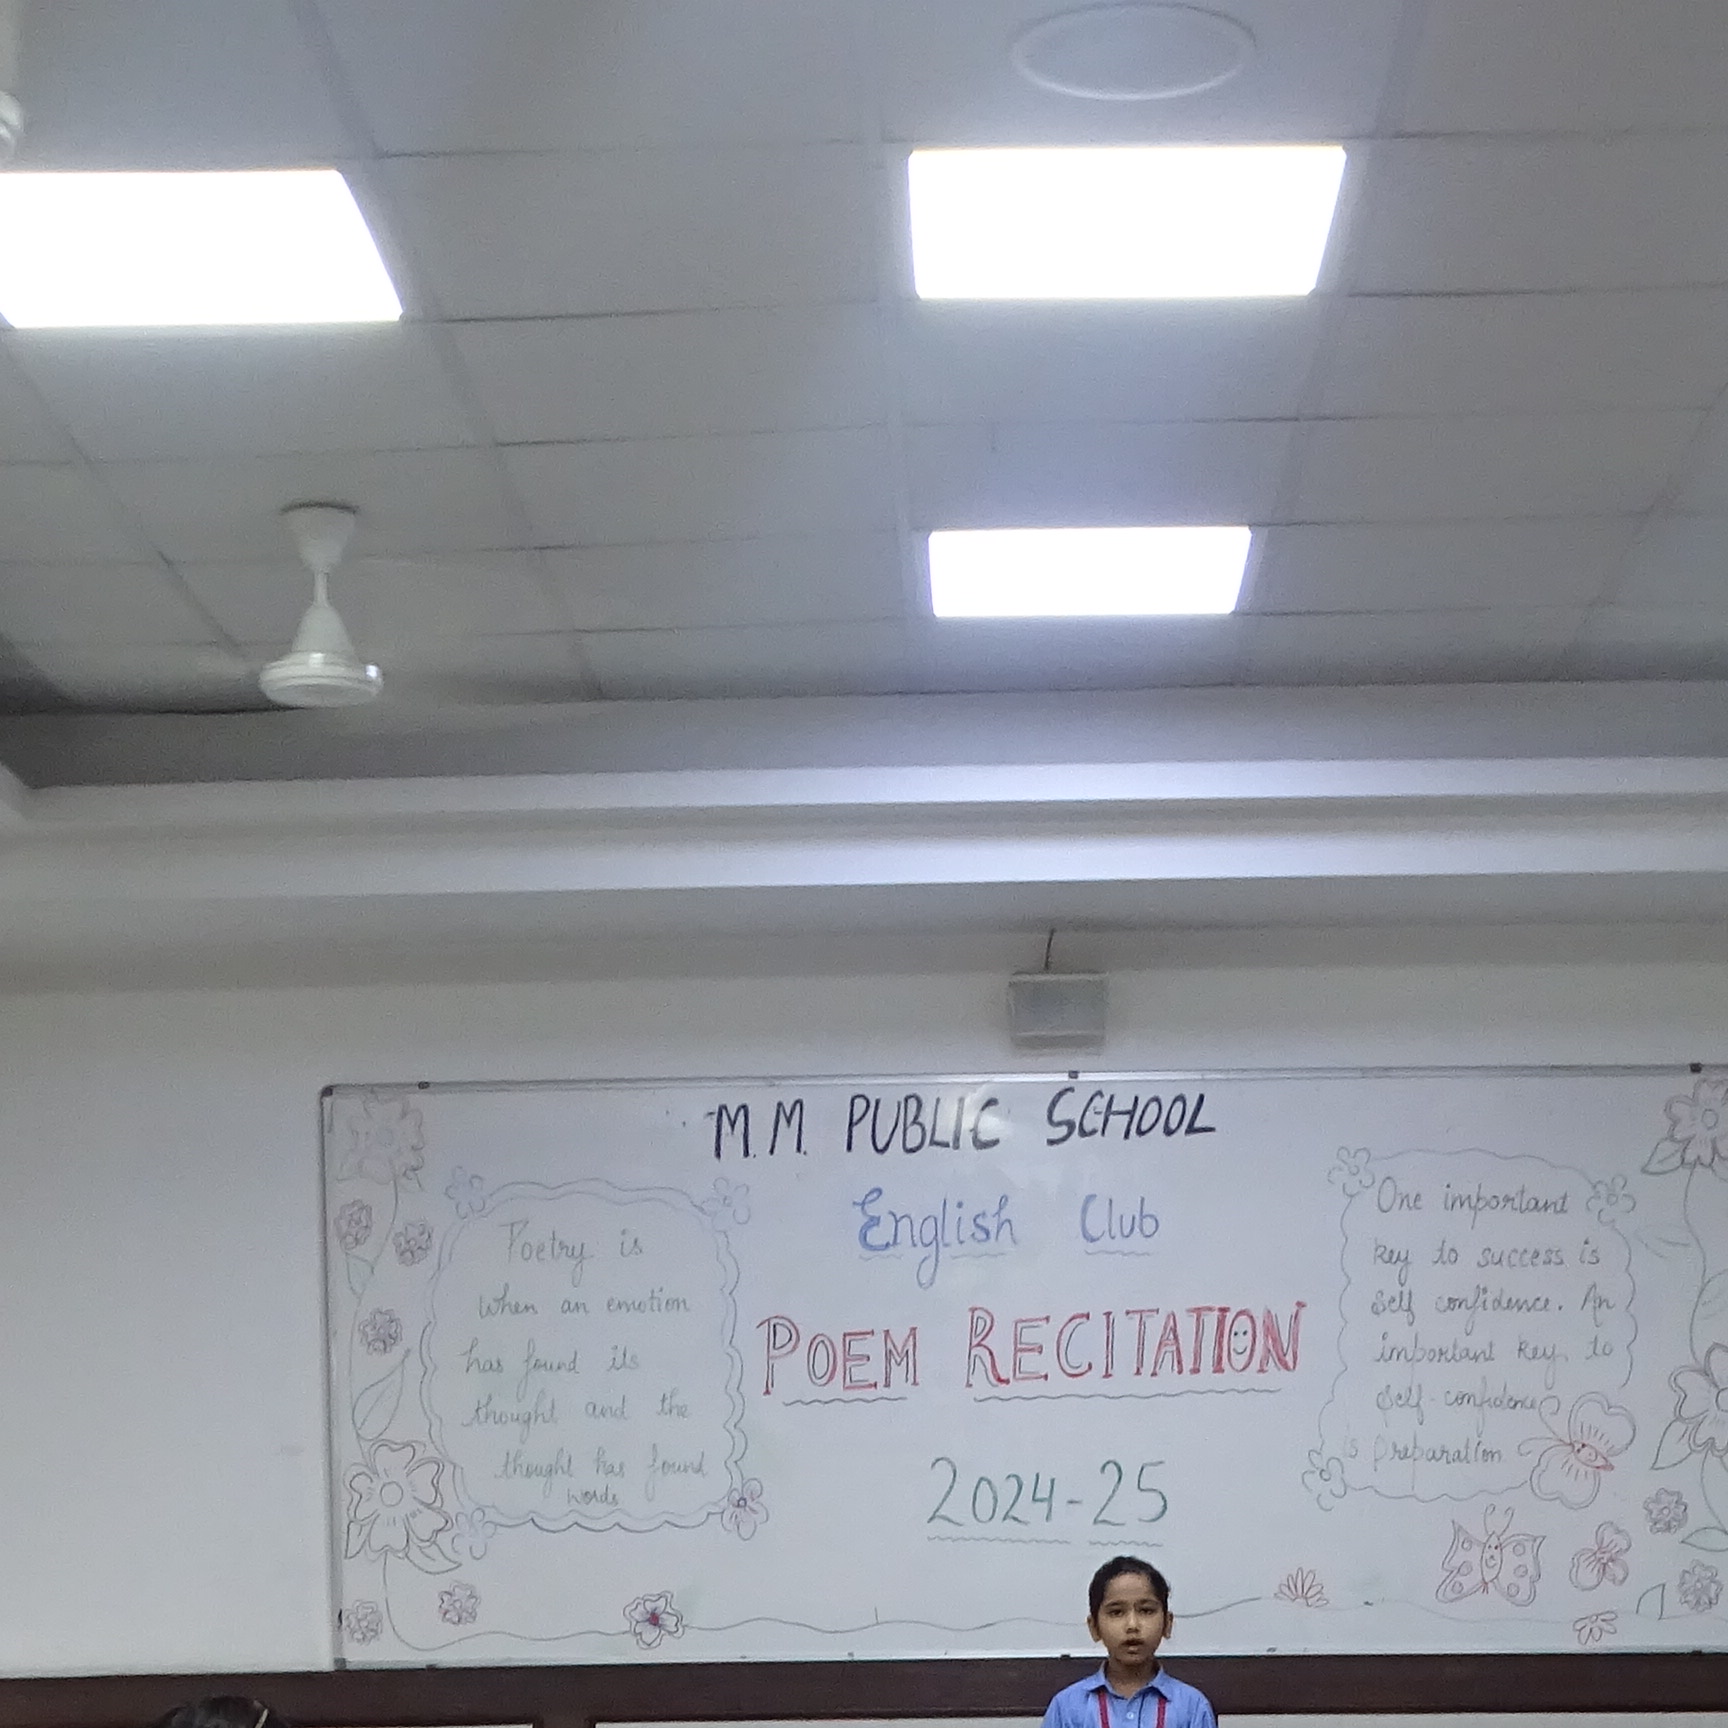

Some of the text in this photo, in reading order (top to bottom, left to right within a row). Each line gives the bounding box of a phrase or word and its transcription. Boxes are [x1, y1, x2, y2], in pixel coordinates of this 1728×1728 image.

[845, 1092, 1002, 1154] PUBLIC
[1045, 1085, 1217, 1148] SCHOOL
[1377, 1175, 1569, 1230] One important
[499, 1219, 644, 1288] Poetry is
[853, 1187, 1161, 1290] English Club
[1432, 1239, 1459, 1266] to
[1476, 1246, 1566, 1269] success
[1578, 1237, 1601, 1266] is
[560, 1298, 590, 1315] an
[606, 1286, 691, 1315] emotion
[1580, 1282, 1616, 1328] An
[458, 1337, 641, 1403] has found its
[756, 1300, 1309, 1396] POEM RECITATION
[1374, 1331, 1496, 1390] important
[1584, 1334, 1614, 1361] to
[461, 1386, 691, 1445] thought and the
[493, 1442, 709, 1503] thought has found
[926, 1455, 1169, 1528] 2024-25
